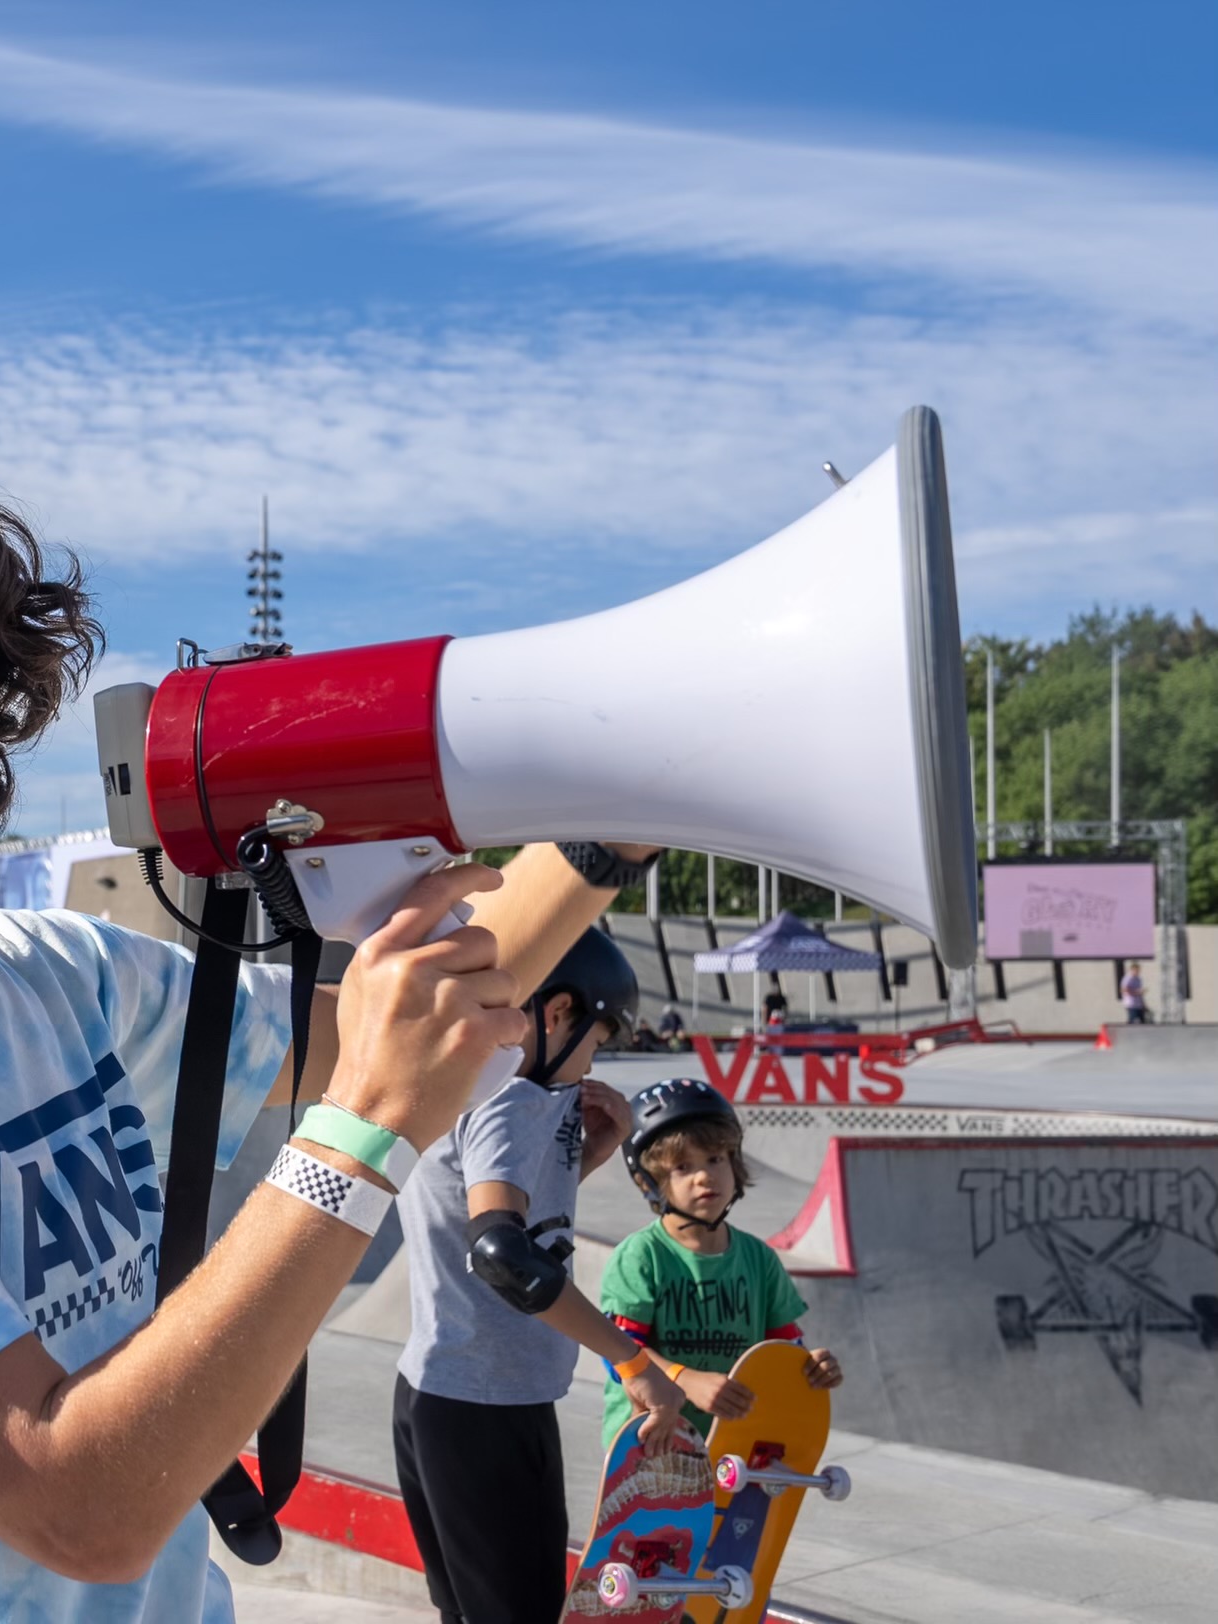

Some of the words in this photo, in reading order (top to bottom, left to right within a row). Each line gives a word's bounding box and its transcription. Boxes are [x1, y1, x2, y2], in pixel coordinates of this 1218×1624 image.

[691, 1034, 907, 1104] VANS
[956, 1115, 1006, 1133] VANS
[957, 1166, 1218, 1259] THRASHER
